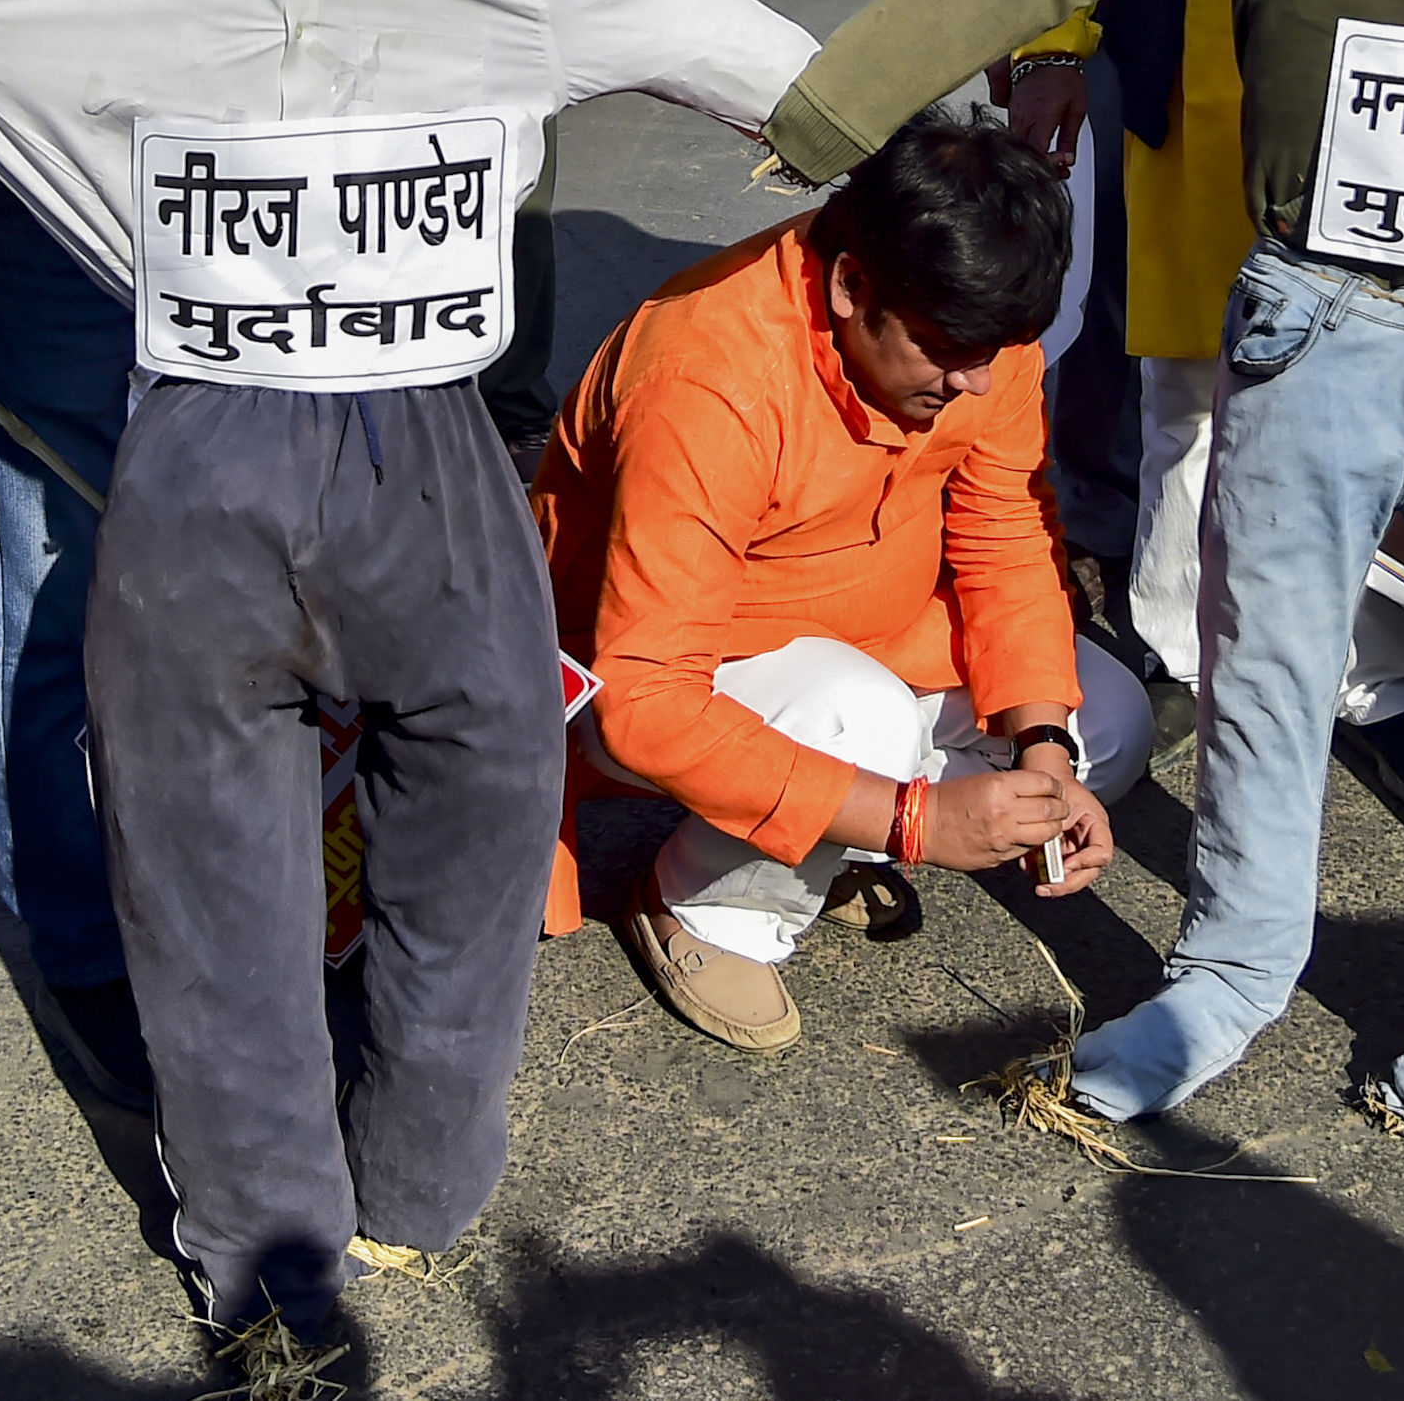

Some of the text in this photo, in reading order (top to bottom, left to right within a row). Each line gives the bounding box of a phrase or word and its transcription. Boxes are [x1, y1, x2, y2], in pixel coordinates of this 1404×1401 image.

[154, 133, 492, 258] नीरज पाण्डेय
[159, 283, 495, 362] मुर्दाबाद
